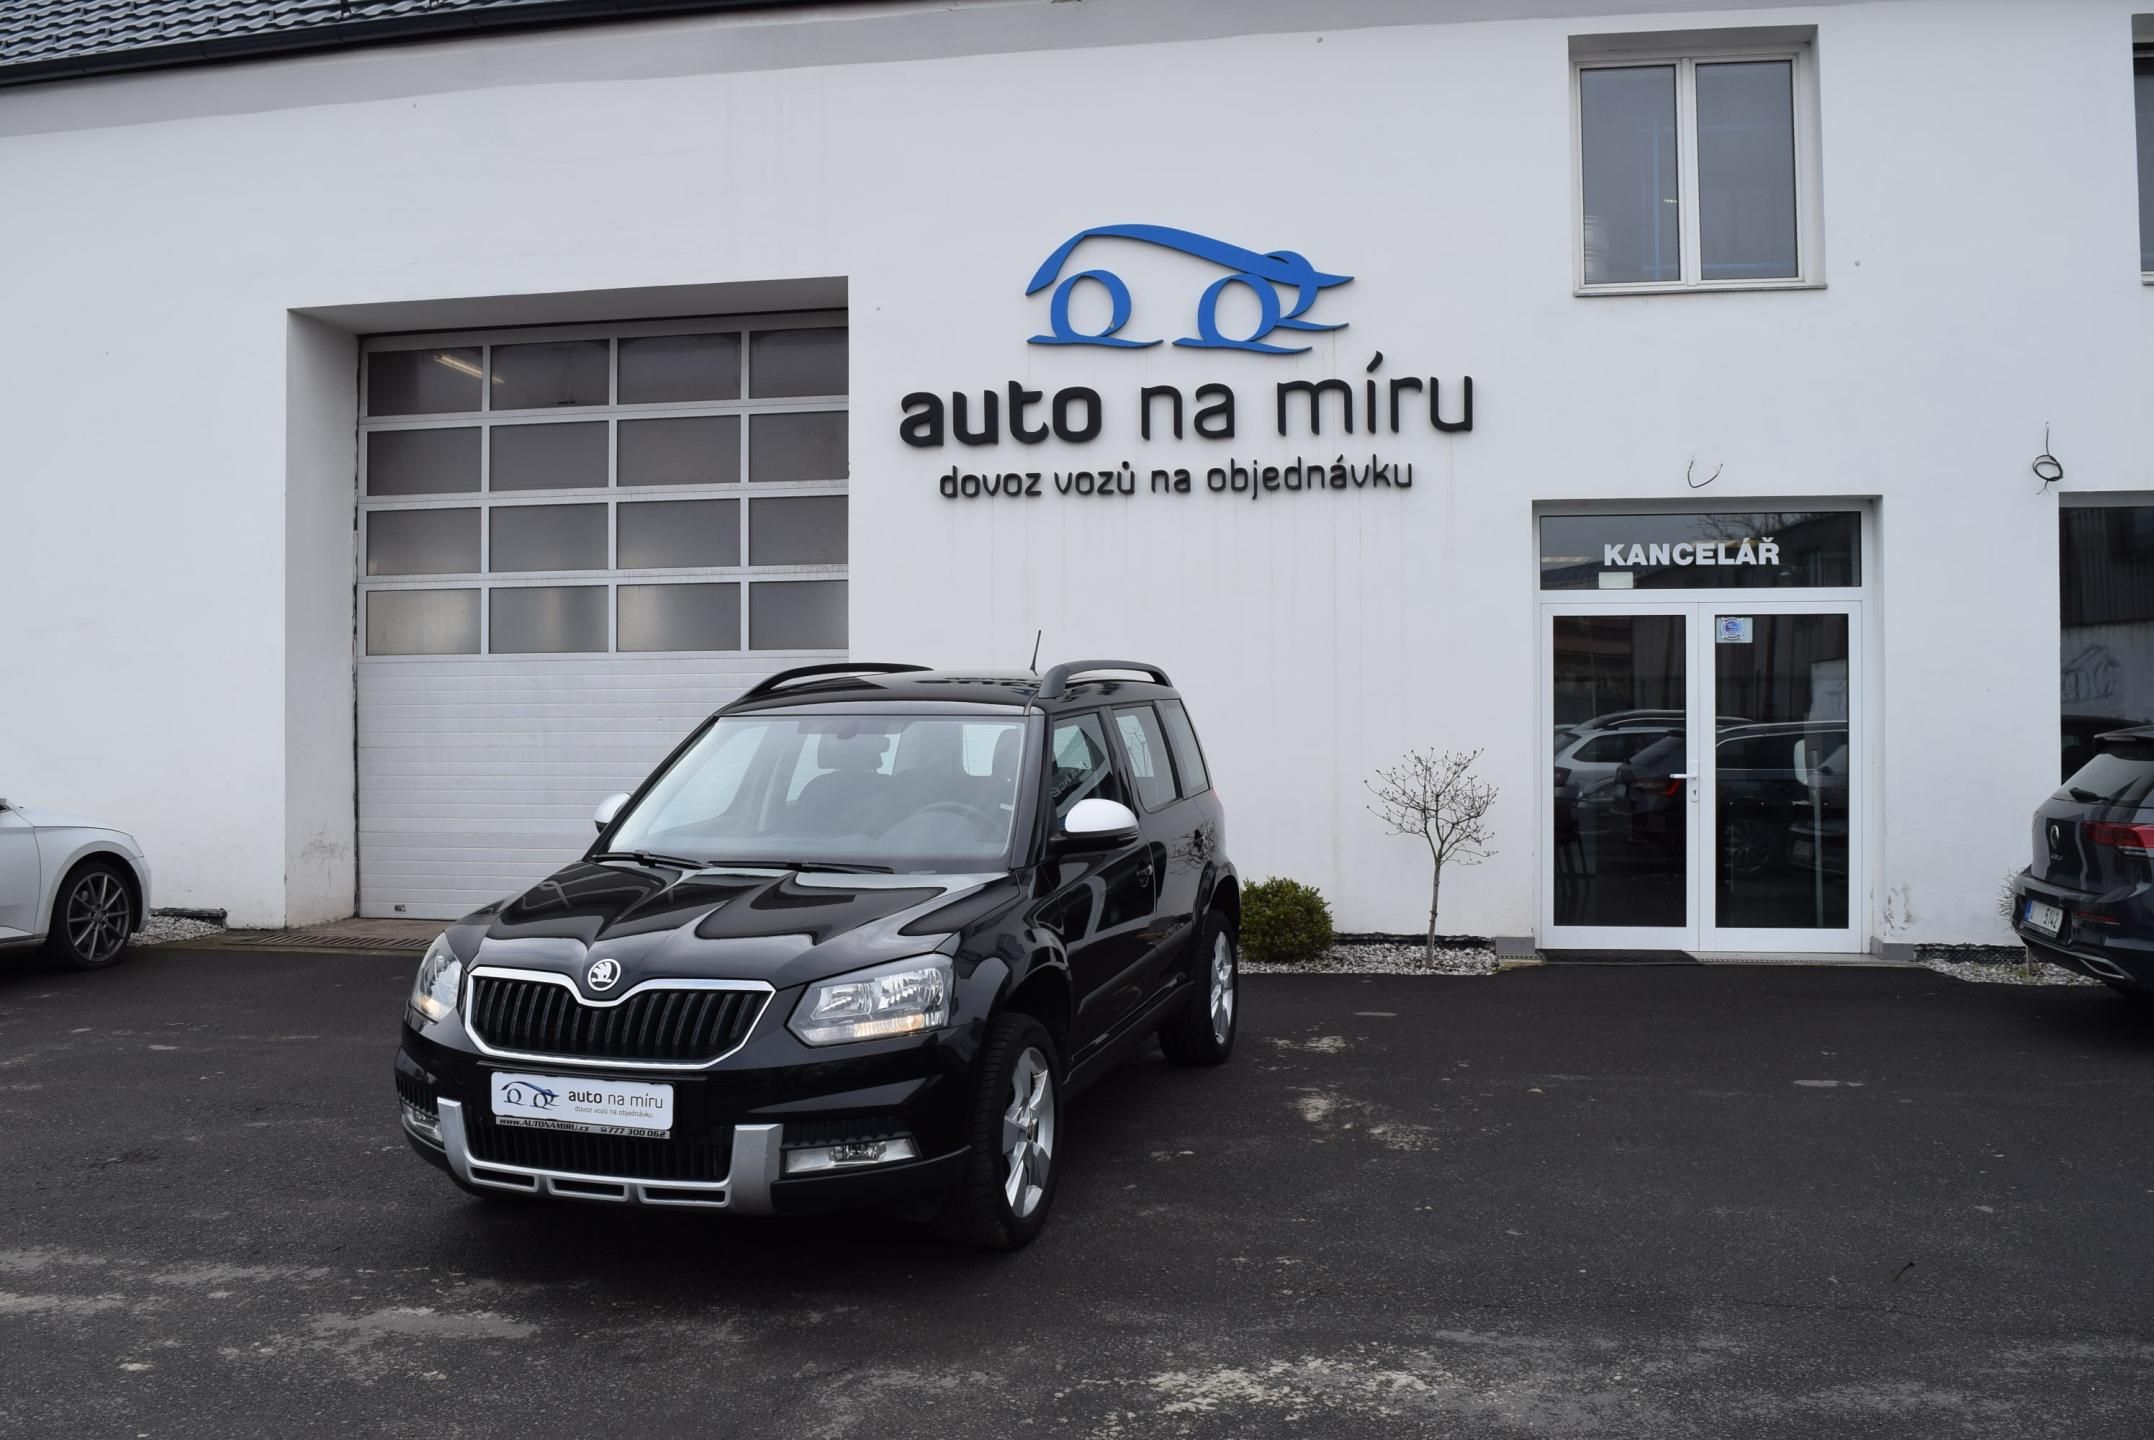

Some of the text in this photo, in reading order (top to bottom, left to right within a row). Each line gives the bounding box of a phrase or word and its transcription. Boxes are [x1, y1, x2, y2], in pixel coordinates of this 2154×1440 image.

[899, 350, 1474, 448] auto na míru
[940, 454, 1413, 501] dovoz vozů na objednávku
[1604, 537, 1780, 566] KANCELÁŘ
[568, 1090, 663, 1109] auto na míru
